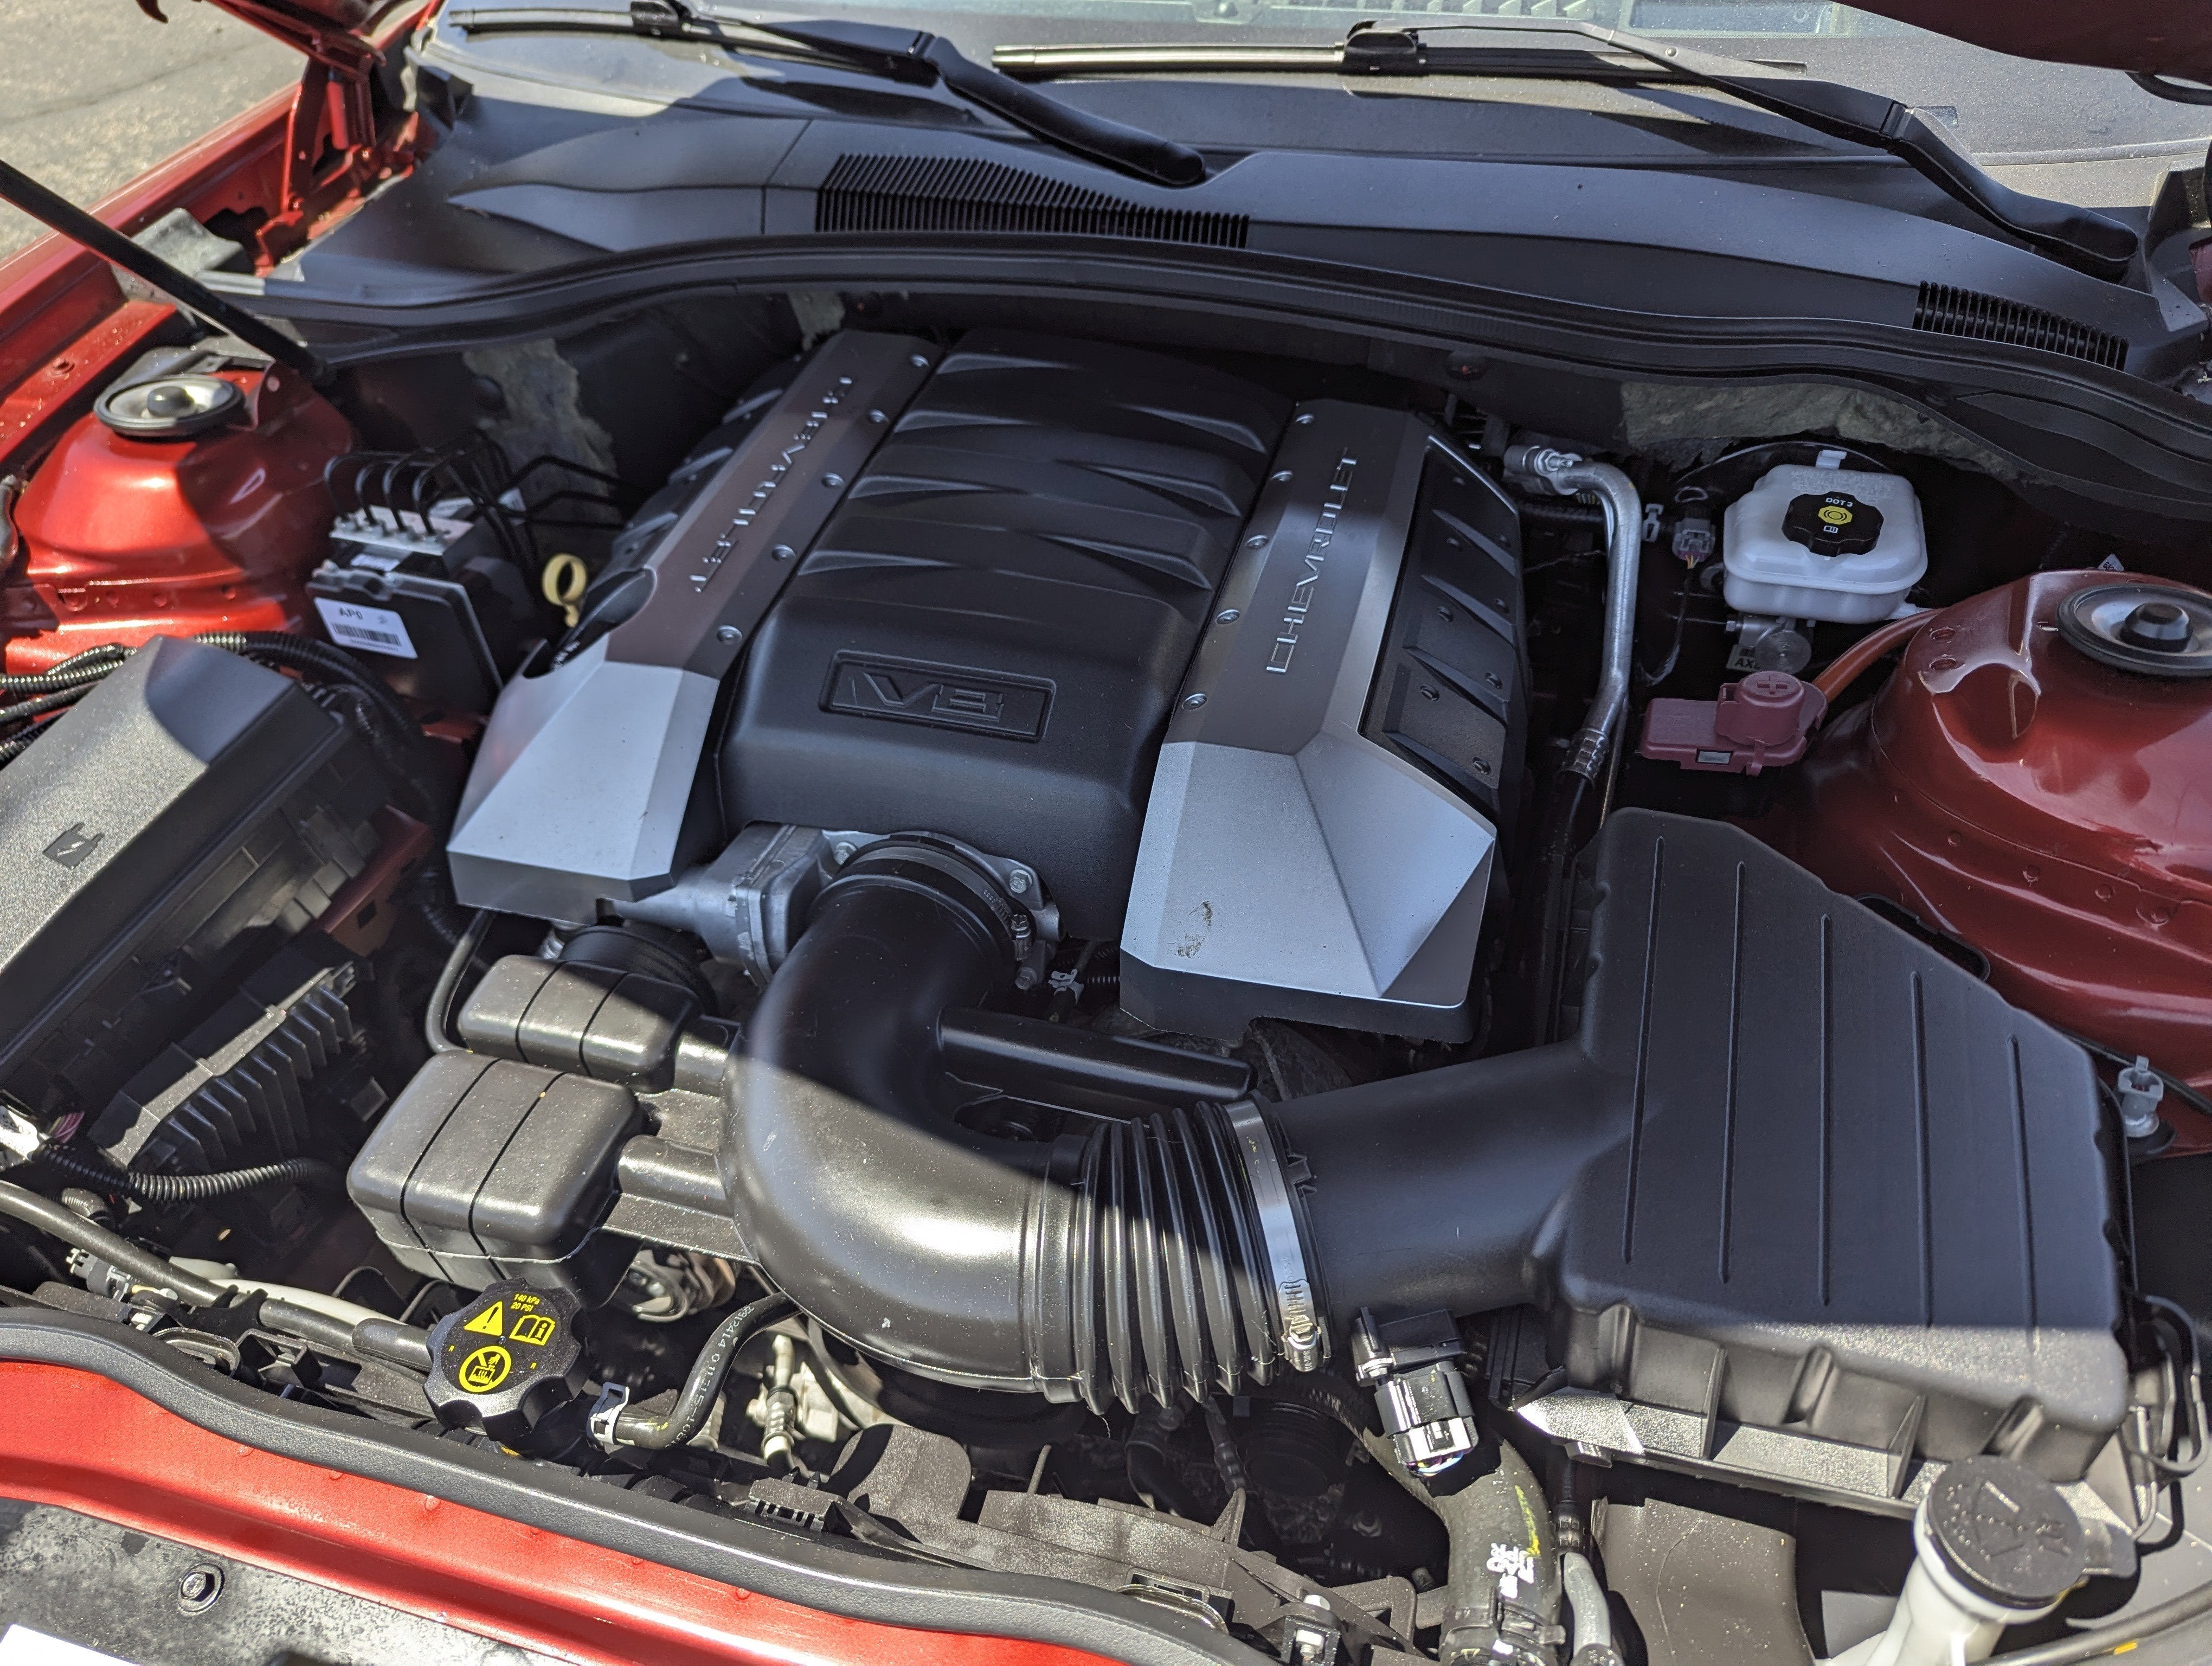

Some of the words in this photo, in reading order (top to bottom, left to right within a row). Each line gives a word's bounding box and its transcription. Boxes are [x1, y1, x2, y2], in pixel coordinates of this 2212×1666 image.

[1825, 497, 1846, 505] DOT
[1265, 447, 1358, 674] CHEVROLET
[514, 1293, 527, 1302] 140
[526, 1296, 540, 1304] kPa
[510, 1302, 522, 1310] 20
[520, 1303, 534, 1312] PSI
